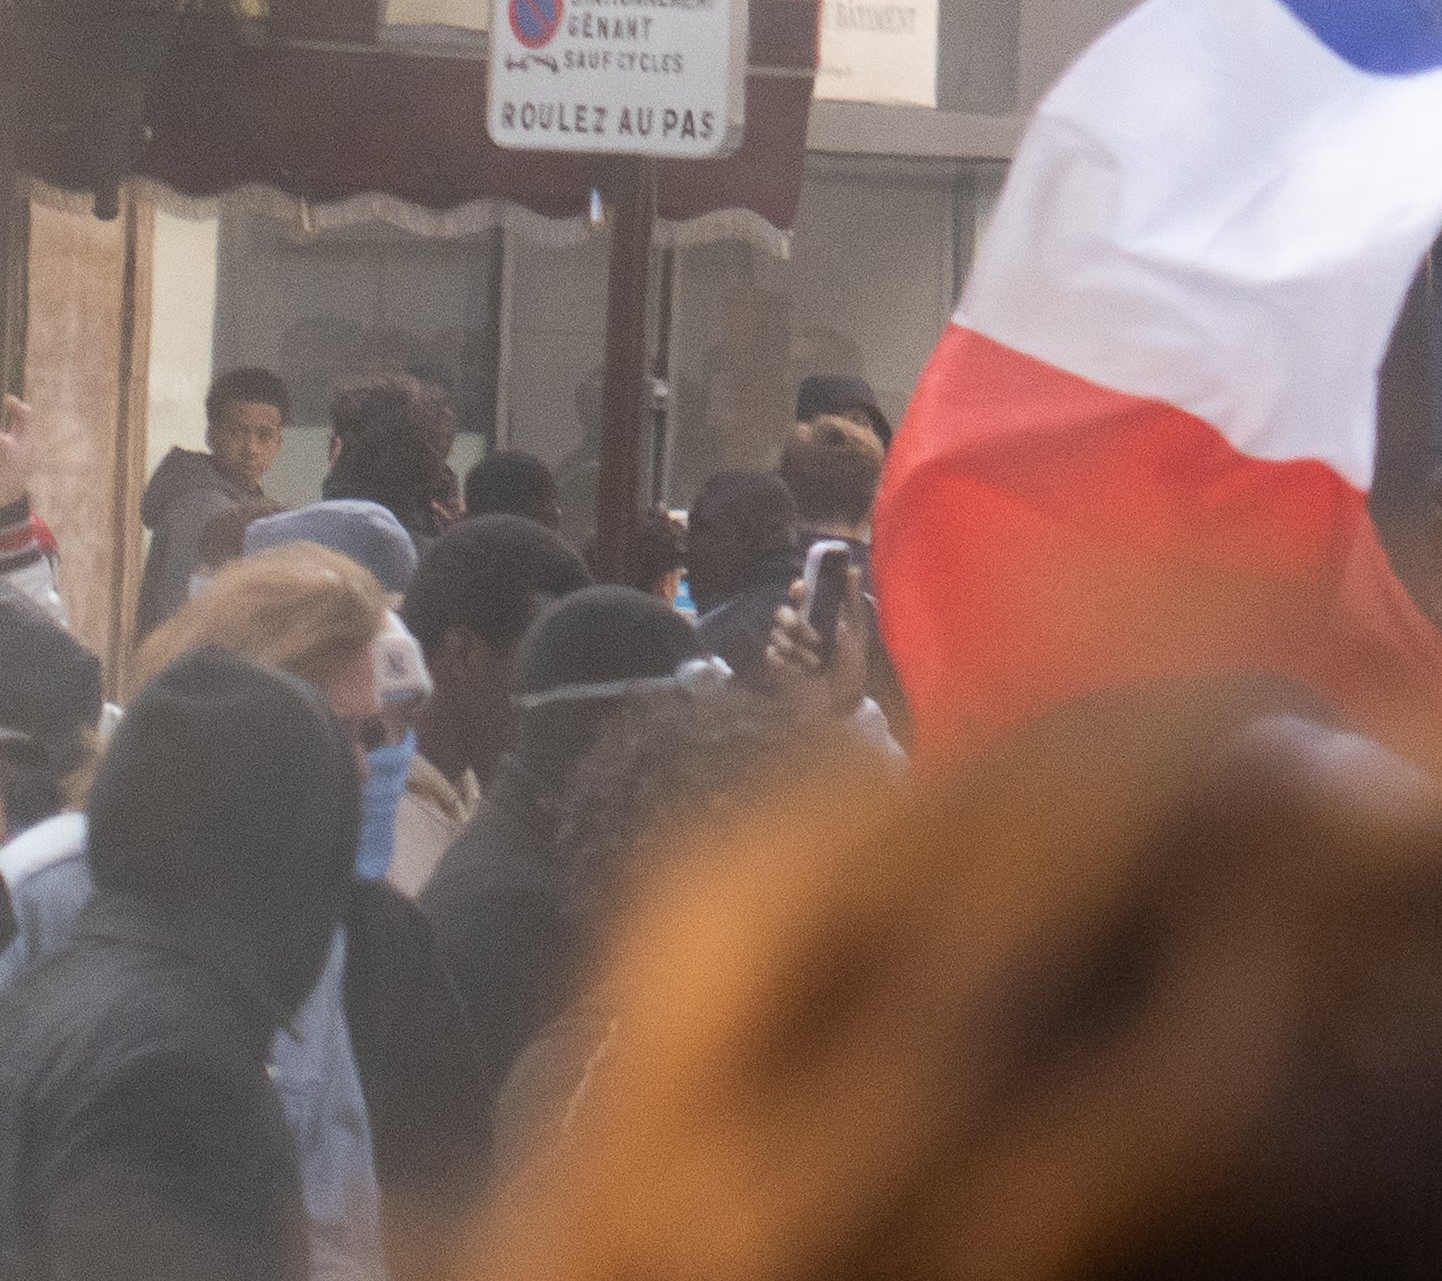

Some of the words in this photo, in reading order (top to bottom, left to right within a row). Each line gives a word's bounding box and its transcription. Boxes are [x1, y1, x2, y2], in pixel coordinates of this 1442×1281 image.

[567, 11, 653, 40] GÊNANT
[563, 49, 611, 70] SAUF
[615, 51, 684, 74] CYCLES
[501, 101, 608, 135] ROULEZ
[617, 107, 653, 137] AU
[662, 108, 715, 139] PAS
